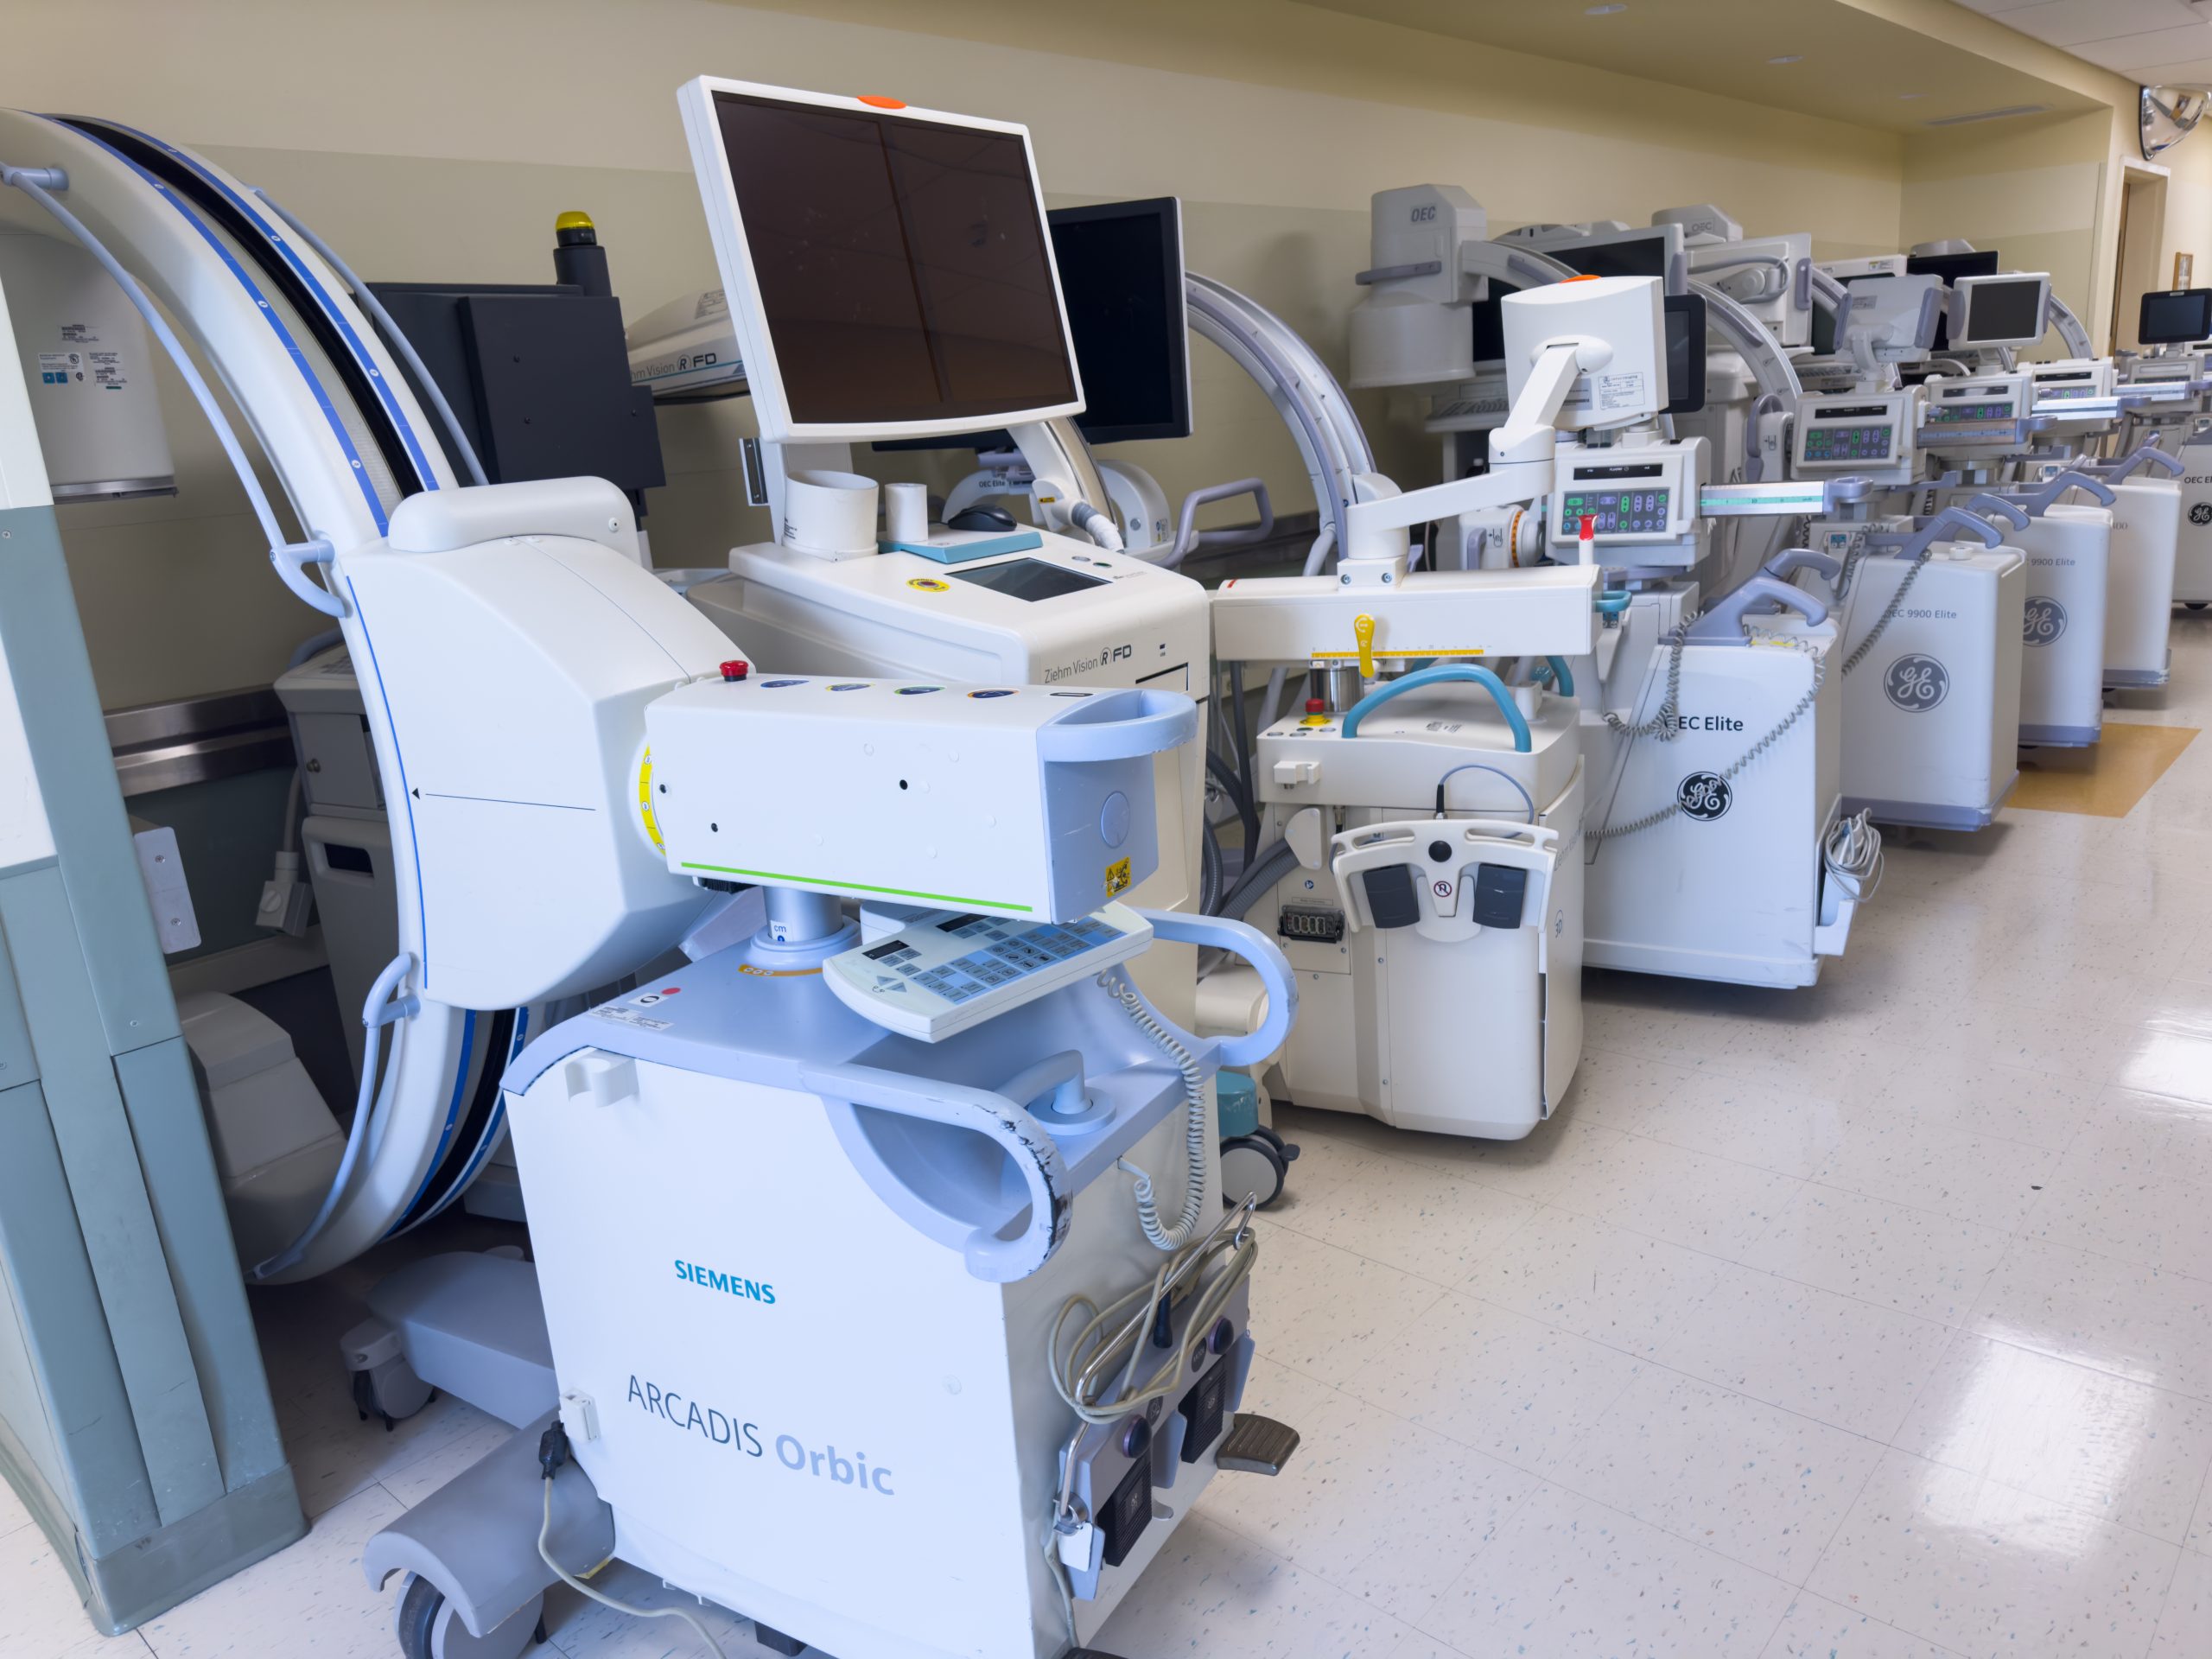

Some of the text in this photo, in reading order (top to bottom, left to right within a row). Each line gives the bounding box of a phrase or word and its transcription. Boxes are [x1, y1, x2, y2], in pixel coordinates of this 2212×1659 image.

[1411, 206, 1437, 222] OEC
[1692, 221, 1713, 232] OEC
[646, 363, 675, 377] Vision
[693, 353, 717, 367] FD
[2055, 557, 2075, 566] Elite
[1891, 609, 1957, 619] EC 9900 Elite
[1044, 666, 1072, 683] Ziehm
[1073, 658, 1098, 674] Vision
[1113, 644, 1132, 662] FD
[1678, 715, 1744, 731] EC Elite
[773, 925, 787, 933] cm
[674, 1259, 776, 1305] SIEMENS
[628, 1374, 895, 1496] ARCADIS Orbic
